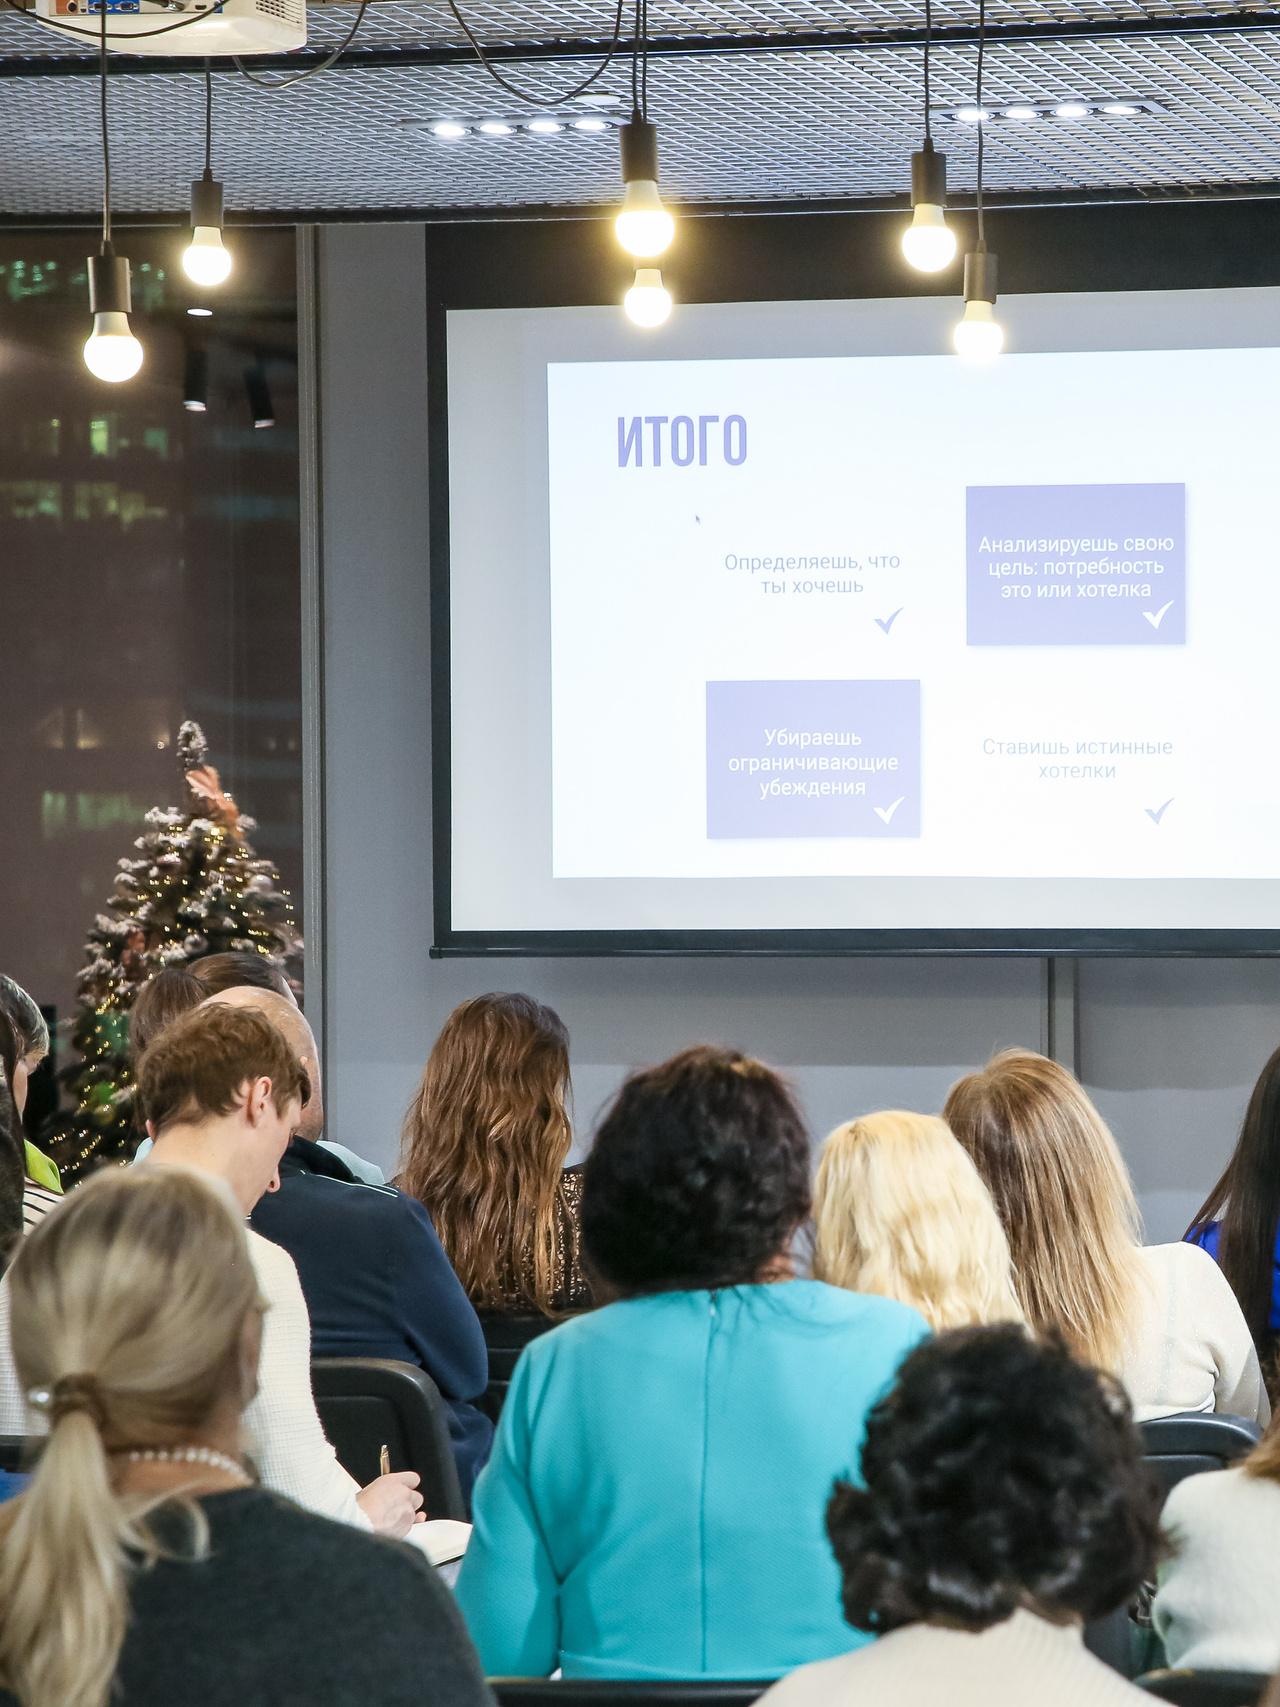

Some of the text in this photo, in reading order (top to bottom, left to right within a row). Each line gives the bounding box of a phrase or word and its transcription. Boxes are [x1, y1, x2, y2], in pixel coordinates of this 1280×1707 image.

[617, 414, 748, 468] ИТОГО
[978, 535, 1175, 556] Анализируешь свою
[724, 553, 901, 575] Определяешь, что
[988, 557, 1165, 579] цель: потребность
[760, 580, 864, 594] ты хочешь
[1001, 583, 1152, 599] это или хотелка
[764, 727, 862, 750] Убираешь
[982, 737, 1173, 755] Ставишь истинные
[728, 756, 899, 776] ограничивающие
[1038, 765, 1116, 779] хотелки
[759, 777, 866, 801] убеждения
